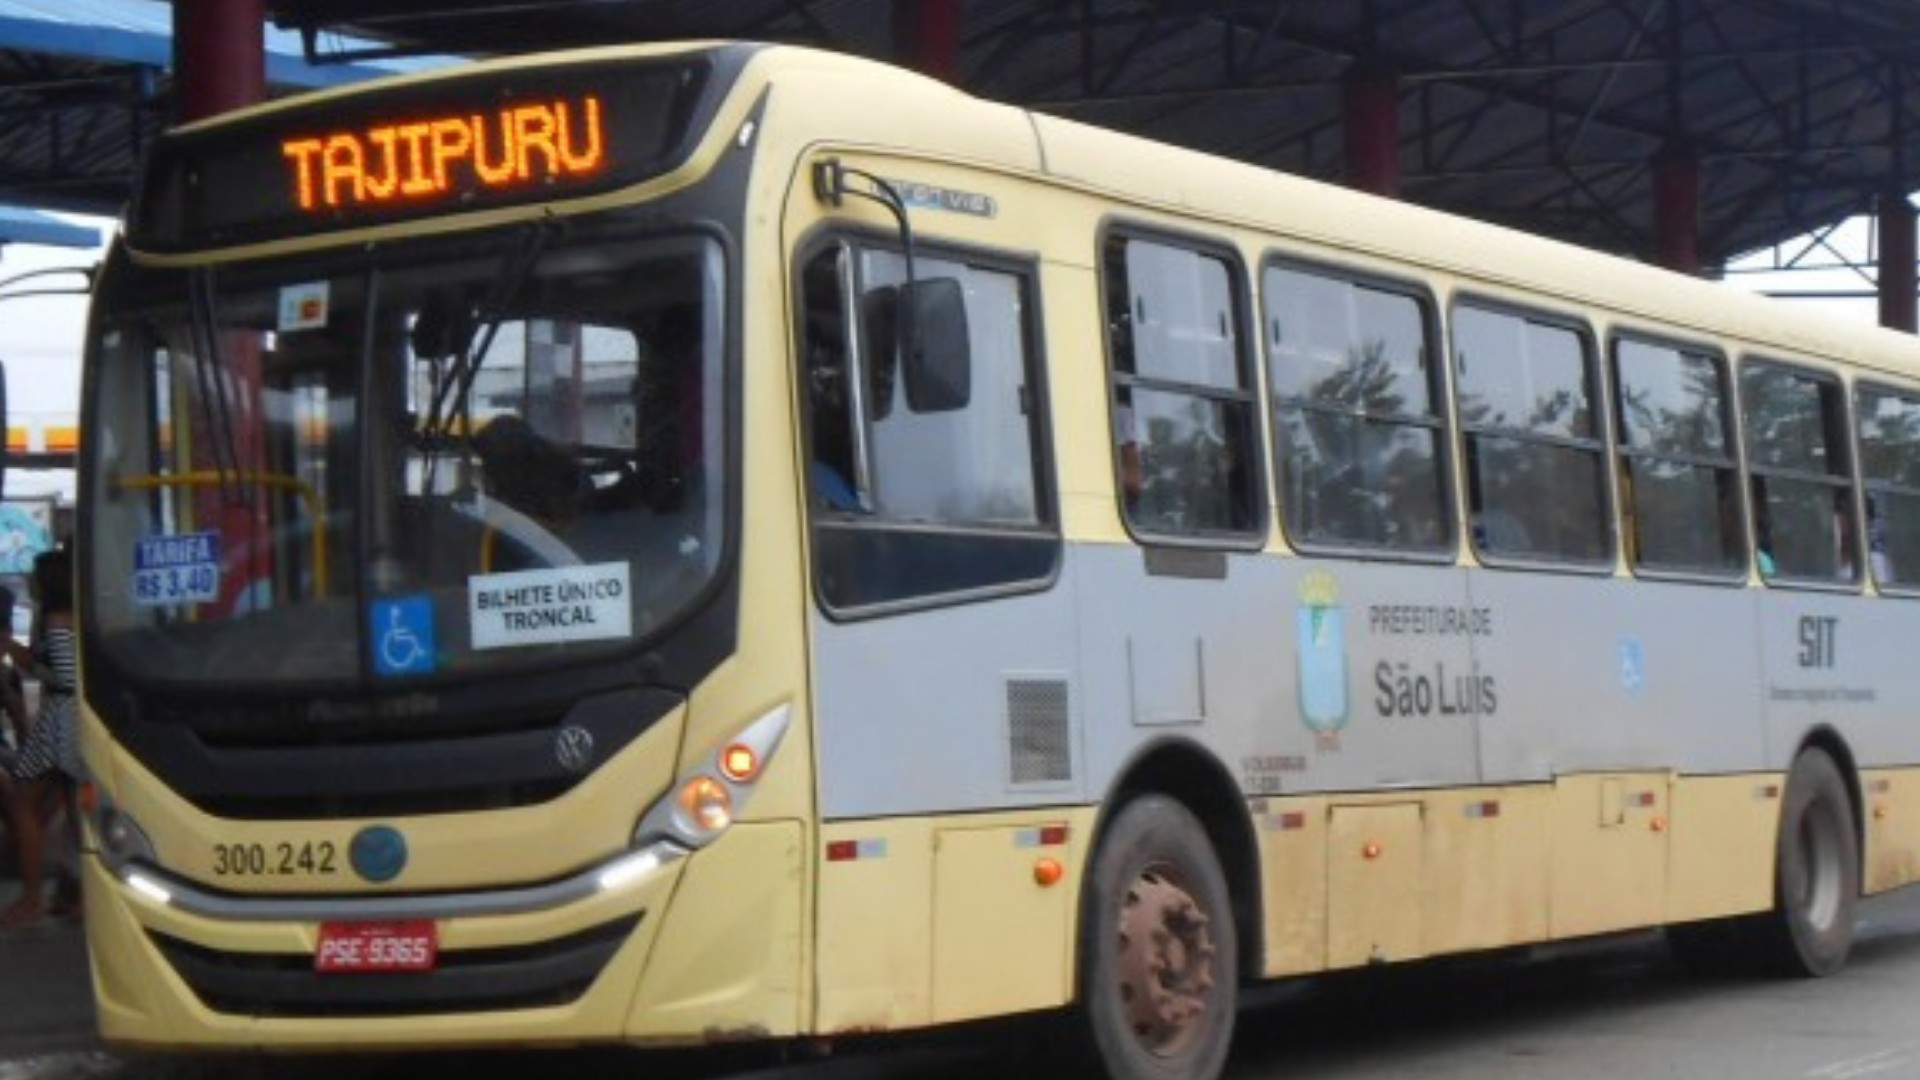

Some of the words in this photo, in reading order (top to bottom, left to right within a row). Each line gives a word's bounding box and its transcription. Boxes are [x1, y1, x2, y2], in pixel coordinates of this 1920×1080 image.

[282, 97, 602, 208] TAJIPURU
[143, 539, 211, 565] TARIFA
[477, 588, 552, 611] BILHETE
[556, 577, 623, 605] ÚNICO
[502, 609, 597, 631] TRONCAL
[1370, 606, 1467, 636] PREFEITURA
[1471, 608, 1493, 636] DE
[1797, 615, 1839, 668] SIT
[1375, 660, 1433, 717] São
[213, 840, 335, 875] 300.242
[318, 939, 362, 965] PSE
